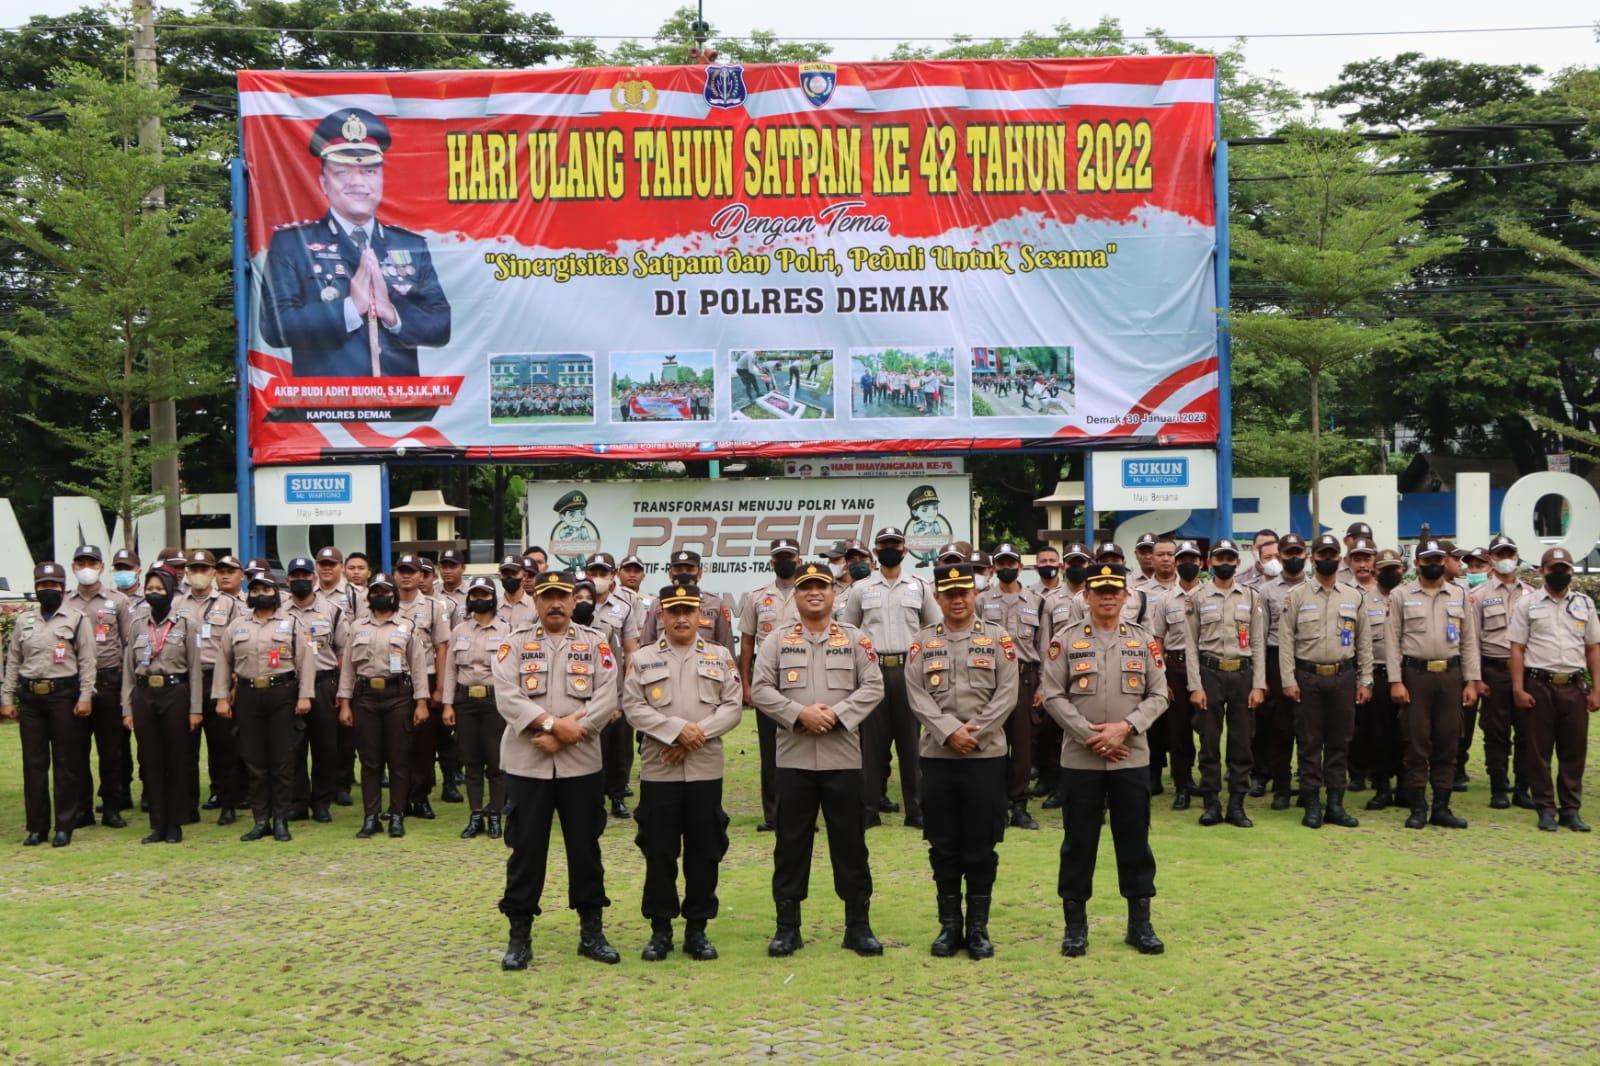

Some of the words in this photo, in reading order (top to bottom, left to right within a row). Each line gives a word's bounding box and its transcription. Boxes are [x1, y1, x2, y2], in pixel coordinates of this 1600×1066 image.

[447, 129, 518, 201] HARI
[528, 128, 625, 201] ULANG
[633, 126, 735, 199] TAHUN
[743, 124, 863, 198] SATPAM
[871, 123, 910, 195] KE
[919, 121, 957, 194] 42
[966, 121, 1066, 193] TAHUN
[1076, 118, 1153, 192] 2022
[711, 203, 815, 245] Dengan
[820, 201, 889, 236] Tema
[485, 251, 629, 282] "Sinergisitas
[633, 250, 722, 280] Satpam
[727, 249, 770, 276] dan
[775, 247, 843, 276] Polri,
[848, 246, 925, 273] Peduli
[930, 244, 1015, 273] Untuk
[1018, 244, 1117, 271] Sesama"
[655, 290, 687, 316] DI
[700, 287, 824, 316] POLRES
[837, 285, 950, 313] DEMAK
[274, 386, 300, 397] AKBP
[301, 386, 323, 397] BUDI
[325, 386, 350, 397] ADHY
[352, 386, 386, 398] BUONO,
[306, 410, 355, 420] KAPOLRES
[357, 410, 392, 419] DEMAK
[1127, 414, 1139, 424] 30
[1142, 413, 1180, 423] Januari
[1182, 412, 1207, 422] 2023
[830, 463, 854, 472] HARI
[1128, 462, 1183, 475] SUKUN
[291, 478, 345, 490] SUKUN
[633, 500, 733, 513] TRANSFORMASI
[738, 500, 793, 512] MENUJU
[797, 499, 836, 511] POLRI
[841, 498, 875, 510] YANG
[626, 514, 875, 558] PRESISI
[567, 652, 592, 661] POLRI
[780, 647, 806, 655] JOHAN
[826, 647, 852, 656] POLRI
[968, 647, 995, 655] POLRI
[1121, 649, 1146, 658] POLRI
